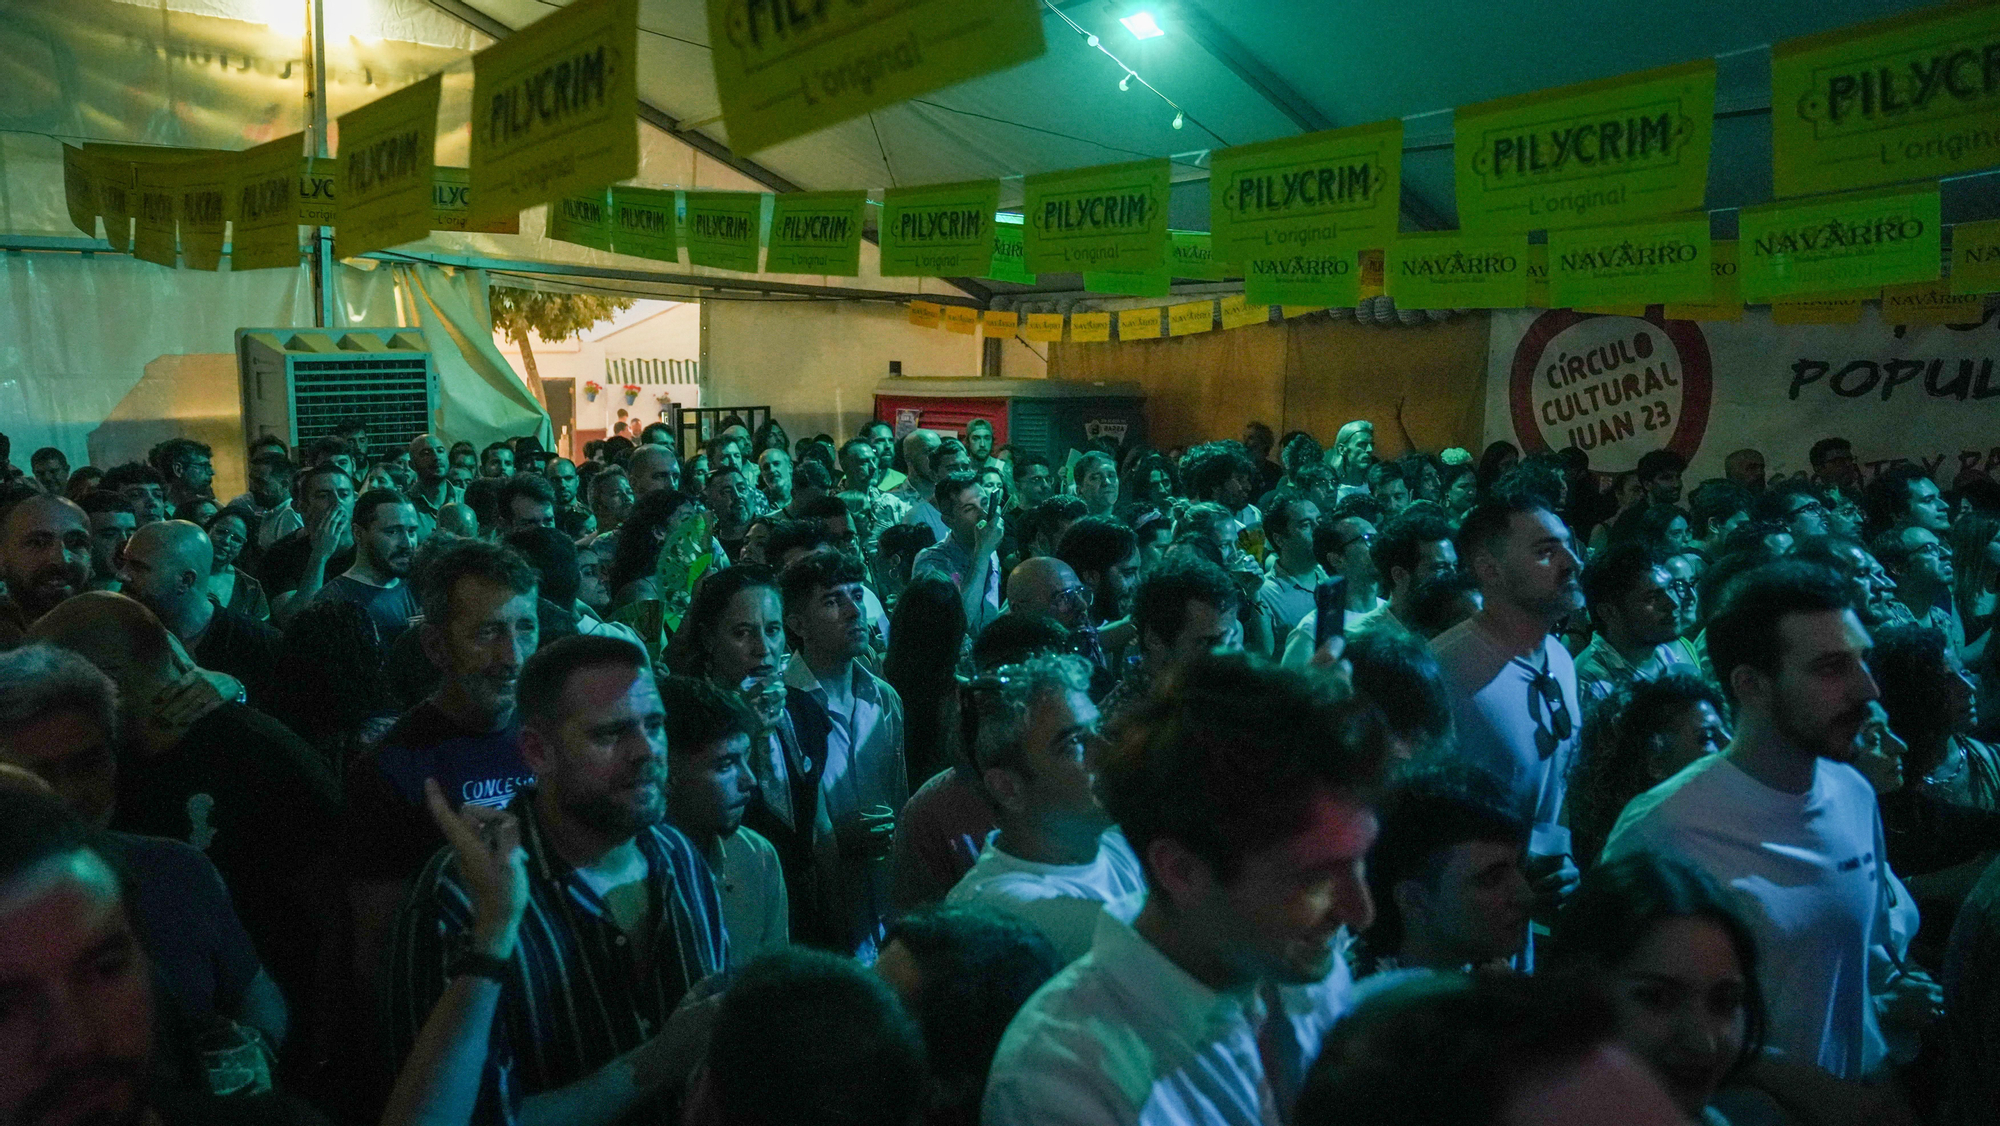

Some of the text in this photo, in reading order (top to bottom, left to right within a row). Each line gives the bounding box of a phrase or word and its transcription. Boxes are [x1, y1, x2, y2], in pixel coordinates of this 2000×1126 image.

[1494, 113, 1671, 177] PILYCRIM
[1239, 163, 1370, 212] PILYCRIM
[1528, 185, 1626, 216] L'original
[621, 207, 666, 233] PILYCRIM
[901, 210, 980, 240] PILYCRIM
[1044, 193, 1146, 231] PILYCRIM
[696, 214, 748, 240] PILYCRIM
[782, 215, 848, 240] PILYCRIM
[1264, 222, 1338, 247] L'original
[1755, 219, 1923, 256] NAVARRO
[914, 254, 959, 270] L'original
[1064, 244, 1120, 264] L'original
[1253, 257, 1349, 275] NAVARRO
[1402, 254, 1517, 276] NAVARRO
[1561, 242, 1697, 271] NAVARRO
[1891, 291, 1977, 307] NAVARRO
[1546, 332, 1654, 389] CÍRCULO
[1541, 362, 1679, 426] CULTURAL
[1568, 401, 1671, 450] JUAN 23
